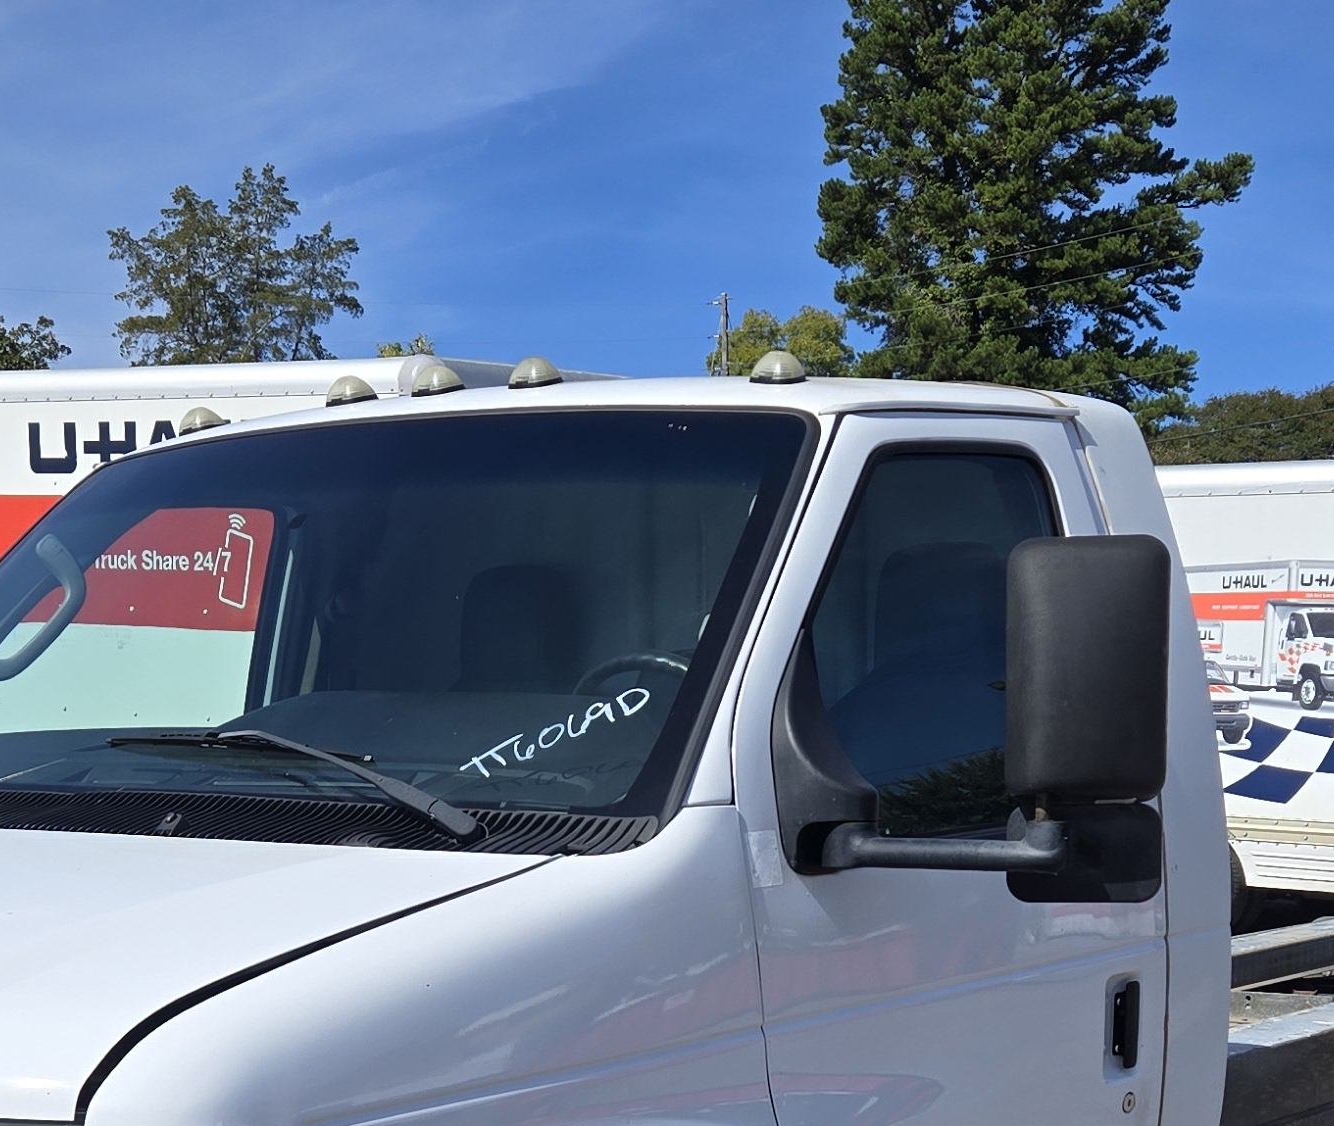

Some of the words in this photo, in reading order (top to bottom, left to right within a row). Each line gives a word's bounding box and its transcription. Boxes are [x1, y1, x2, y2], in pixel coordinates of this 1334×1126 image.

[141, 550, 190, 571] Share
[193, 547, 232, 576] 24/7
[1222, 574, 1267, 590] U-HAUL
